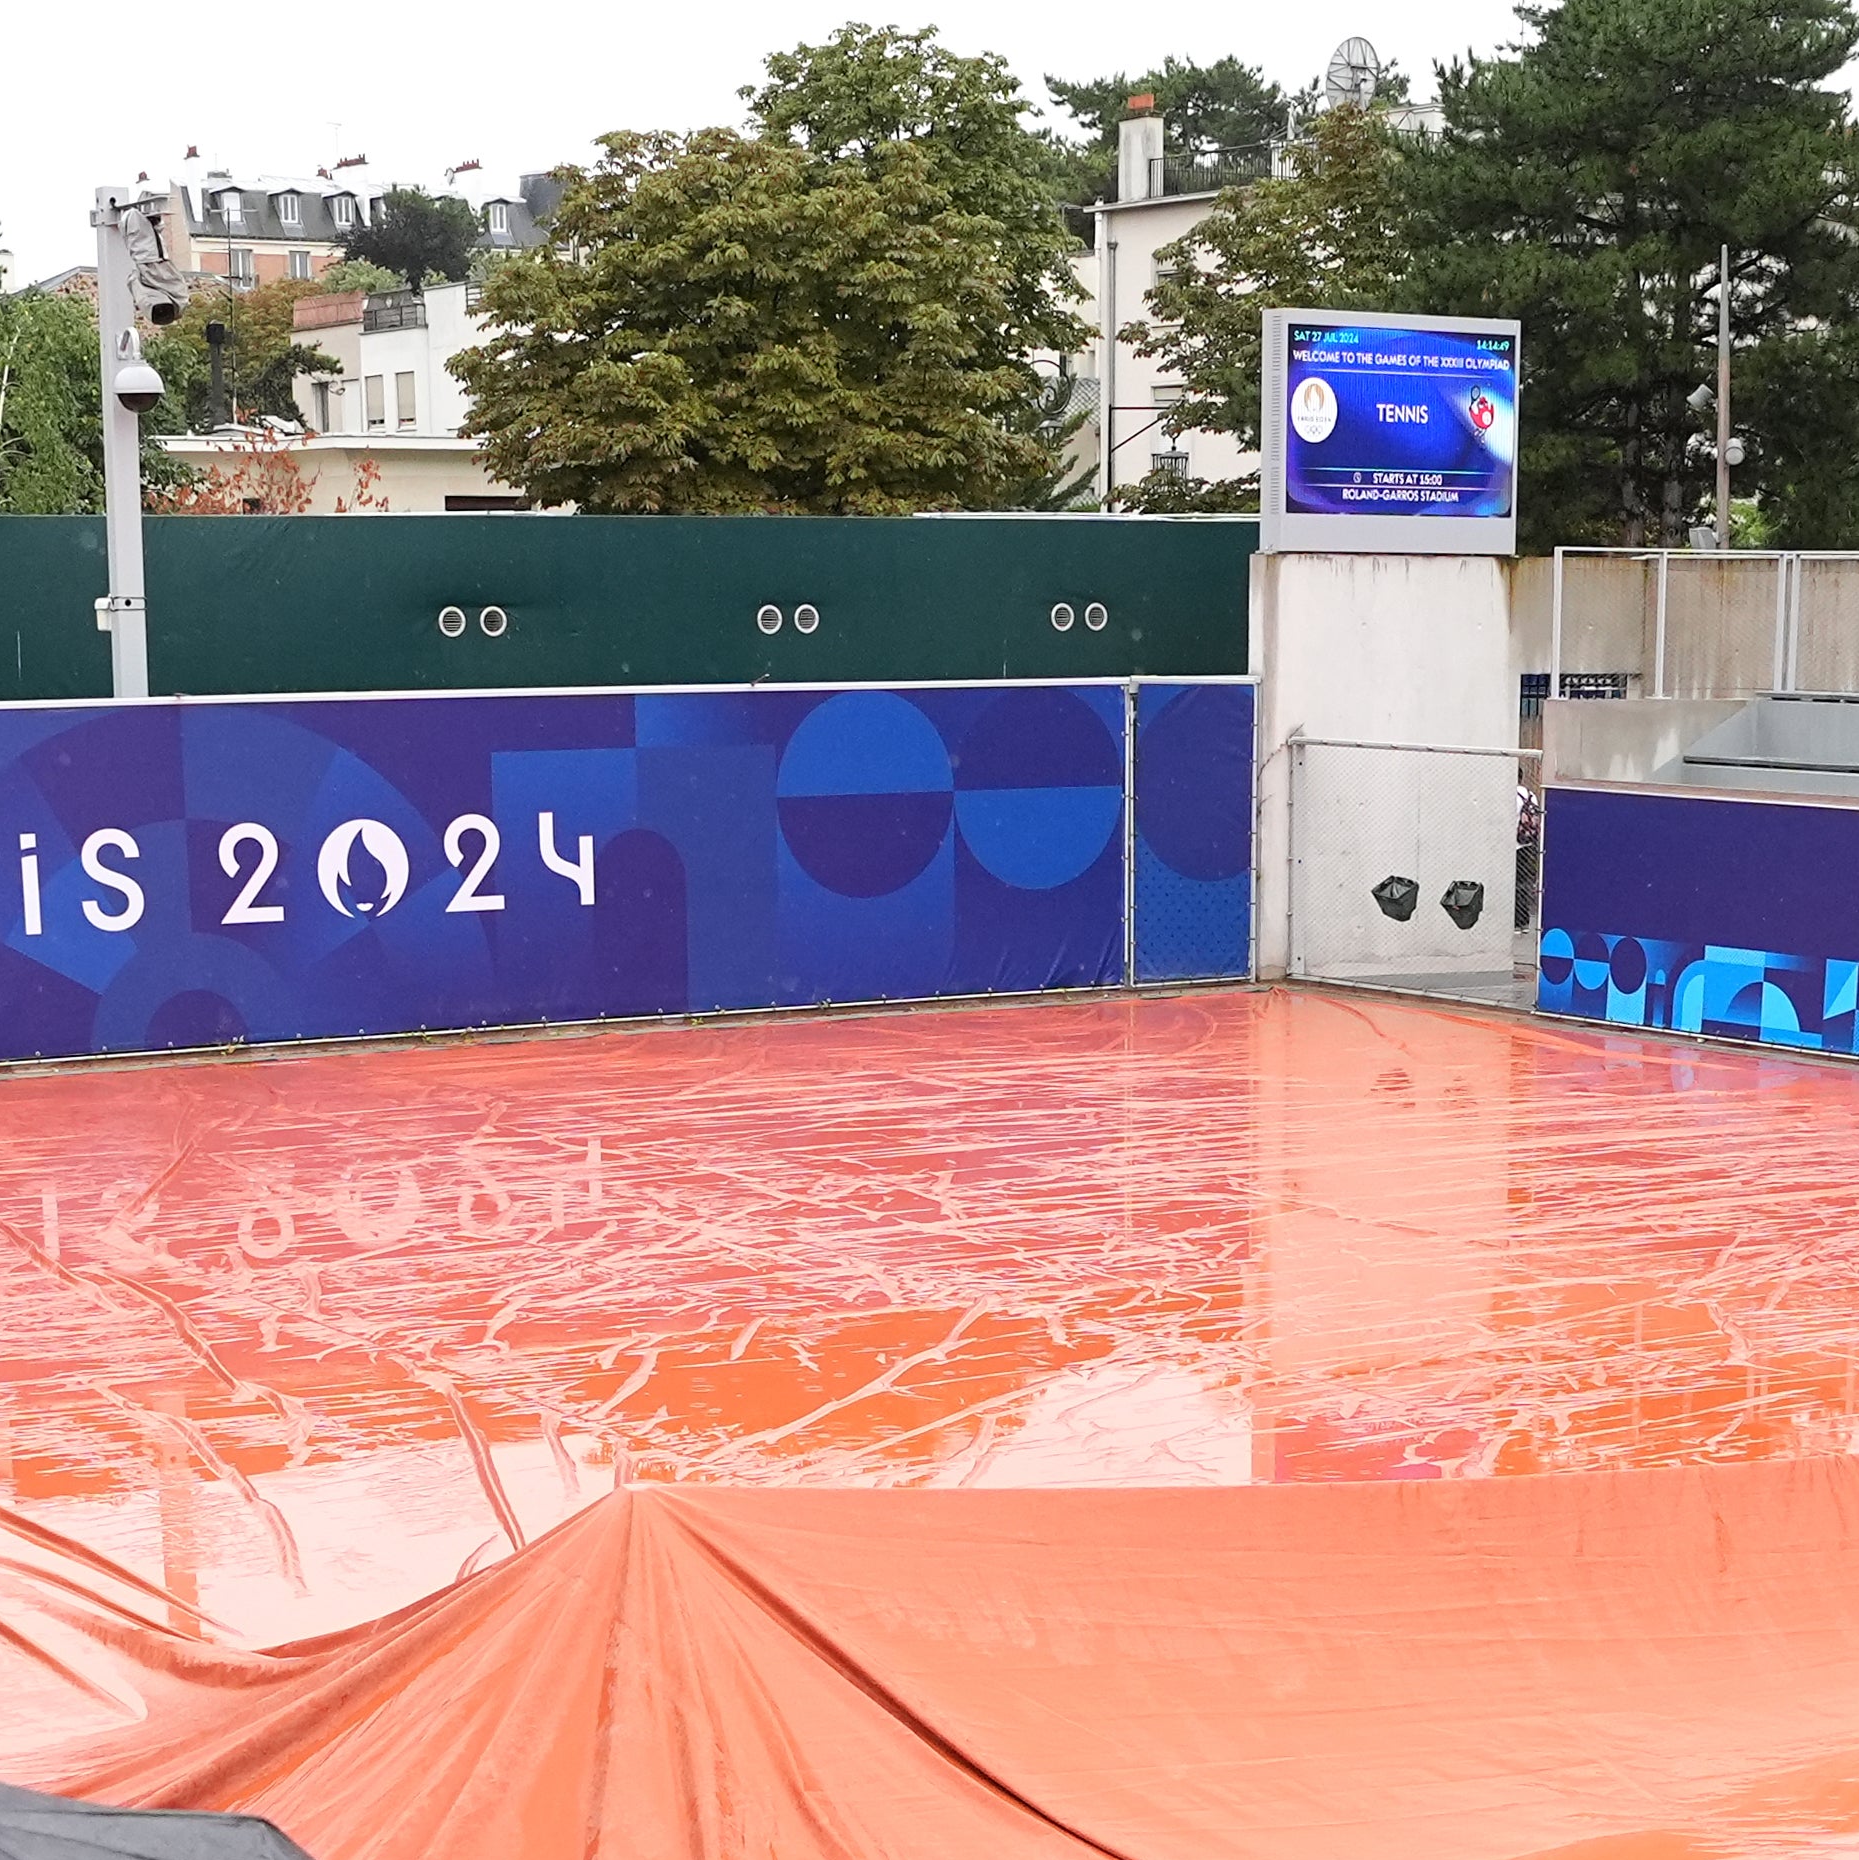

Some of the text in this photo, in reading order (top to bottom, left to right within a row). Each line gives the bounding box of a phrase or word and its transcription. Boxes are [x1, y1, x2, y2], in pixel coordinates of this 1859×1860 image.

[1293, 330, 1359, 344] SAT 27 JUL 2024
[1292, 350, 1340, 363] WELCOME
[1342, 352, 1355, 364] TO
[1356, 353, 1374, 365] THE
[1375, 354, 1407, 367] GAMES
[1408, 355, 1422, 367] OF
[1423, 356, 1440, 368] THE
[1465, 358, 1511, 371] OLYMPIAD
[1376, 403, 1429, 425] TENNIS
[1372, 472, 1443, 486] STARTS AT 15:00
[1342, 488, 1459, 503] ROLAND-GARROS STADIUM
[217, 810, 596, 926] 2024
